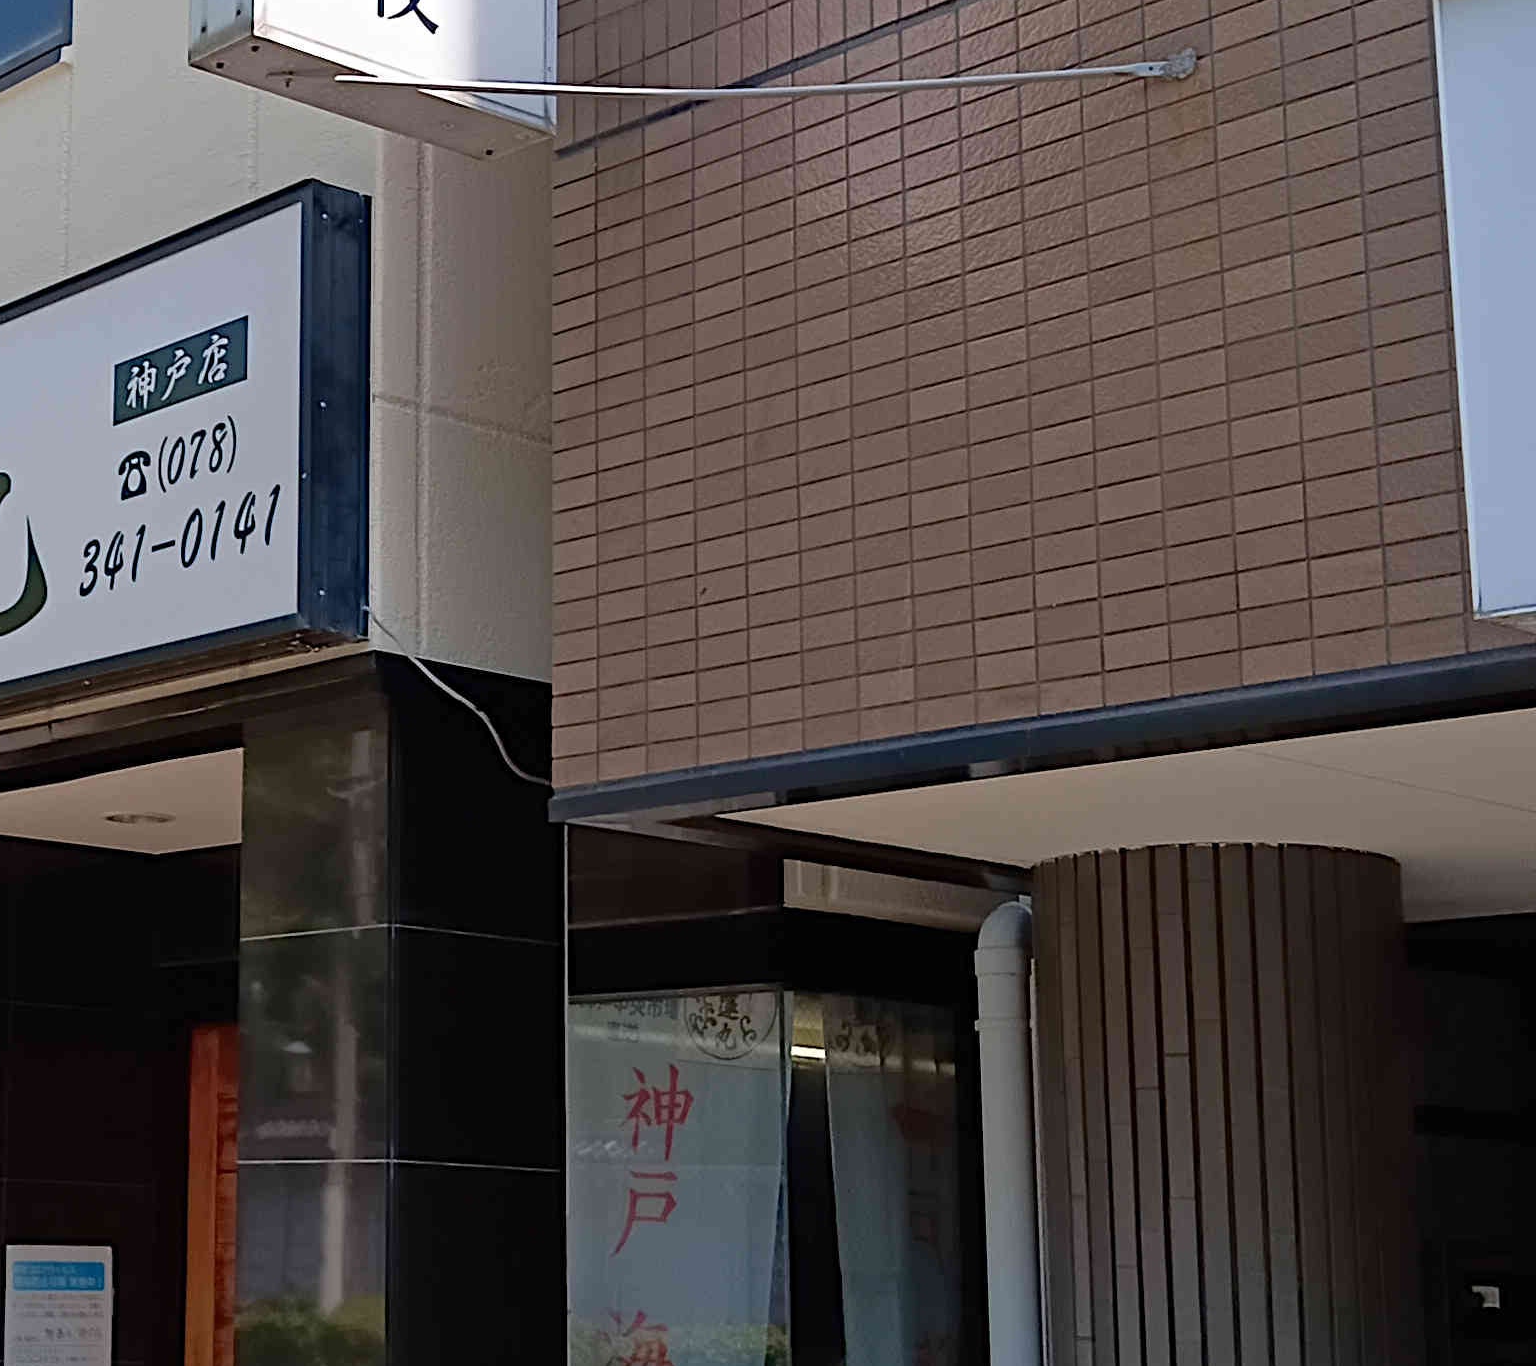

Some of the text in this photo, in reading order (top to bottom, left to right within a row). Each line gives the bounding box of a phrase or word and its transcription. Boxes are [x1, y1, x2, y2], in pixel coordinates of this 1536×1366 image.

[125, 334, 230, 410] 神戸店
[79, 483, 281, 597] 341-0141
[612, 1063, 695, 1257] 神戸
